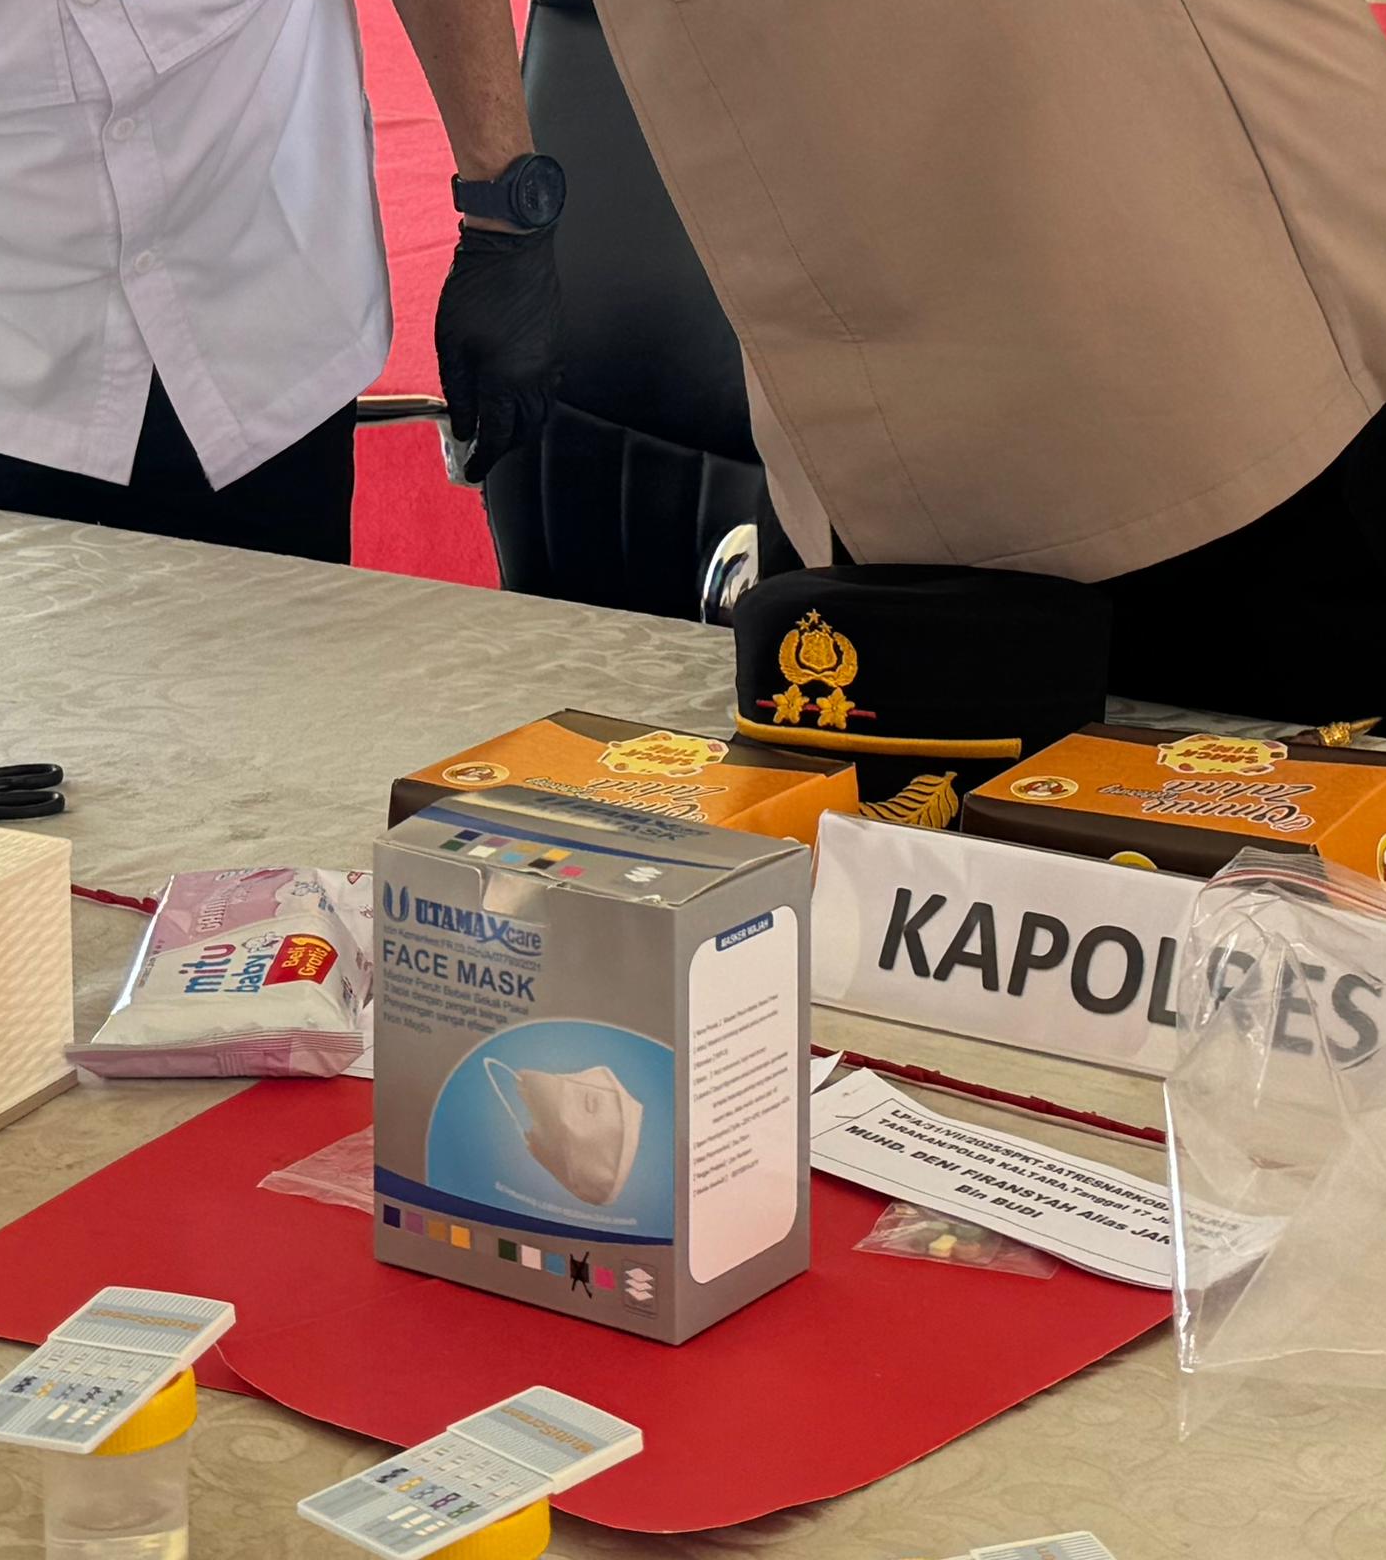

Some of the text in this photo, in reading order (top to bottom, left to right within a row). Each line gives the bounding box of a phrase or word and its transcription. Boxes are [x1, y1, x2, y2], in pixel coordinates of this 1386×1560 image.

[179, 943, 237, 993] mitu
[224, 954, 275, 993] baby
[281, 945, 308, 969] Beli
[298, 947, 329, 977] Gratis
[383, 940, 449, 980] FACE
[457, 959, 536, 1003] MASK
[877, 886, 1383, 1064] KAPOLRES
[845, 1125, 906, 1154] MUHD.
[910, 1151, 962, 1172] DENI
[960, 1168, 1078, 1213] FIRANSYAH
[1076, 1210, 1129, 1231] Alias
[878, 1118, 997, 1166] TARAKAN/POLDA
[1070, 1186, 1130, 1212] Tanggal
[1133, 1208, 1151, 1217] 17
[954, 1184, 1045, 1219] Bin BUDI
